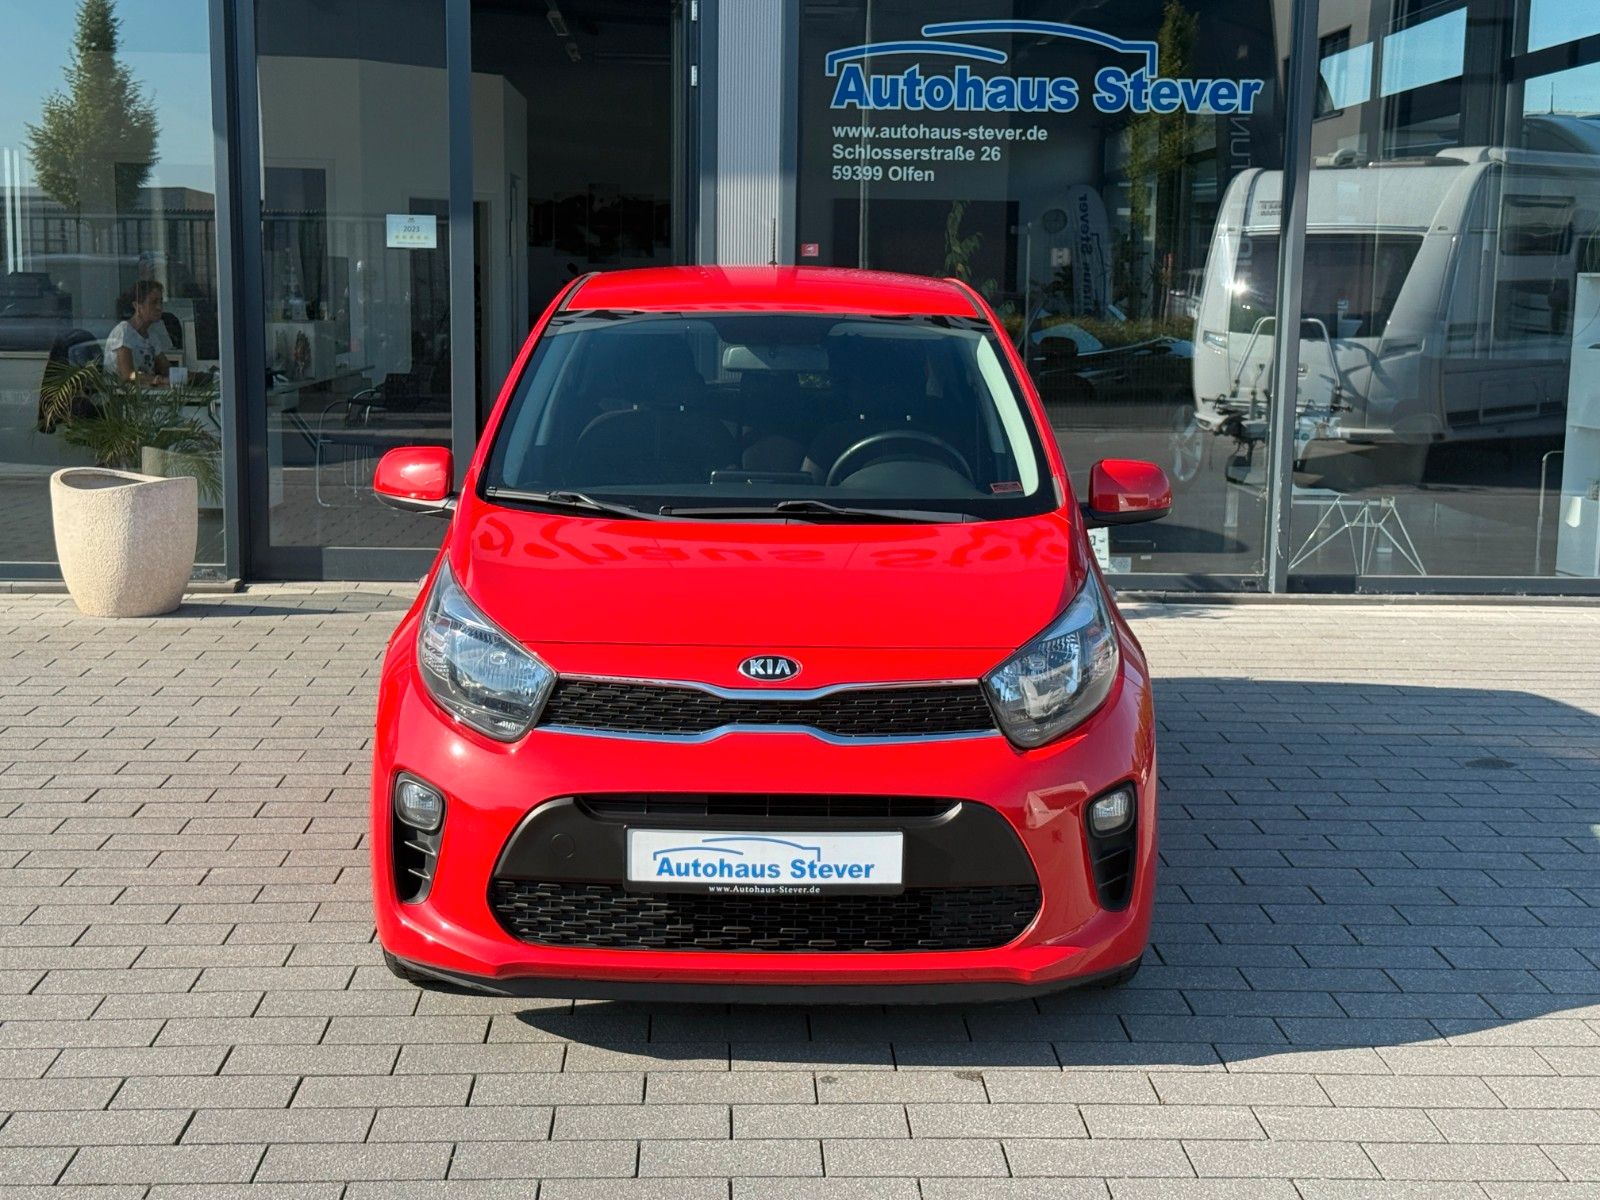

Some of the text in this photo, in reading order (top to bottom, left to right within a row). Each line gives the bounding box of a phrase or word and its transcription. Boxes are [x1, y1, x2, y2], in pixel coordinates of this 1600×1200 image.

[830, 63, 1264, 114] Autohaus Stever
[832, 123, 1048, 141] www.autohaus-stever.de
[832, 143, 1001, 161] Schlosserstraße 26
[831, 165, 935, 182] 59399 Olfen
[749, 658, 791, 675] KIA
[656, 857, 875, 878] Autohaus Stever
[708, 883, 822, 894] www.Autohaus-Stever.de
